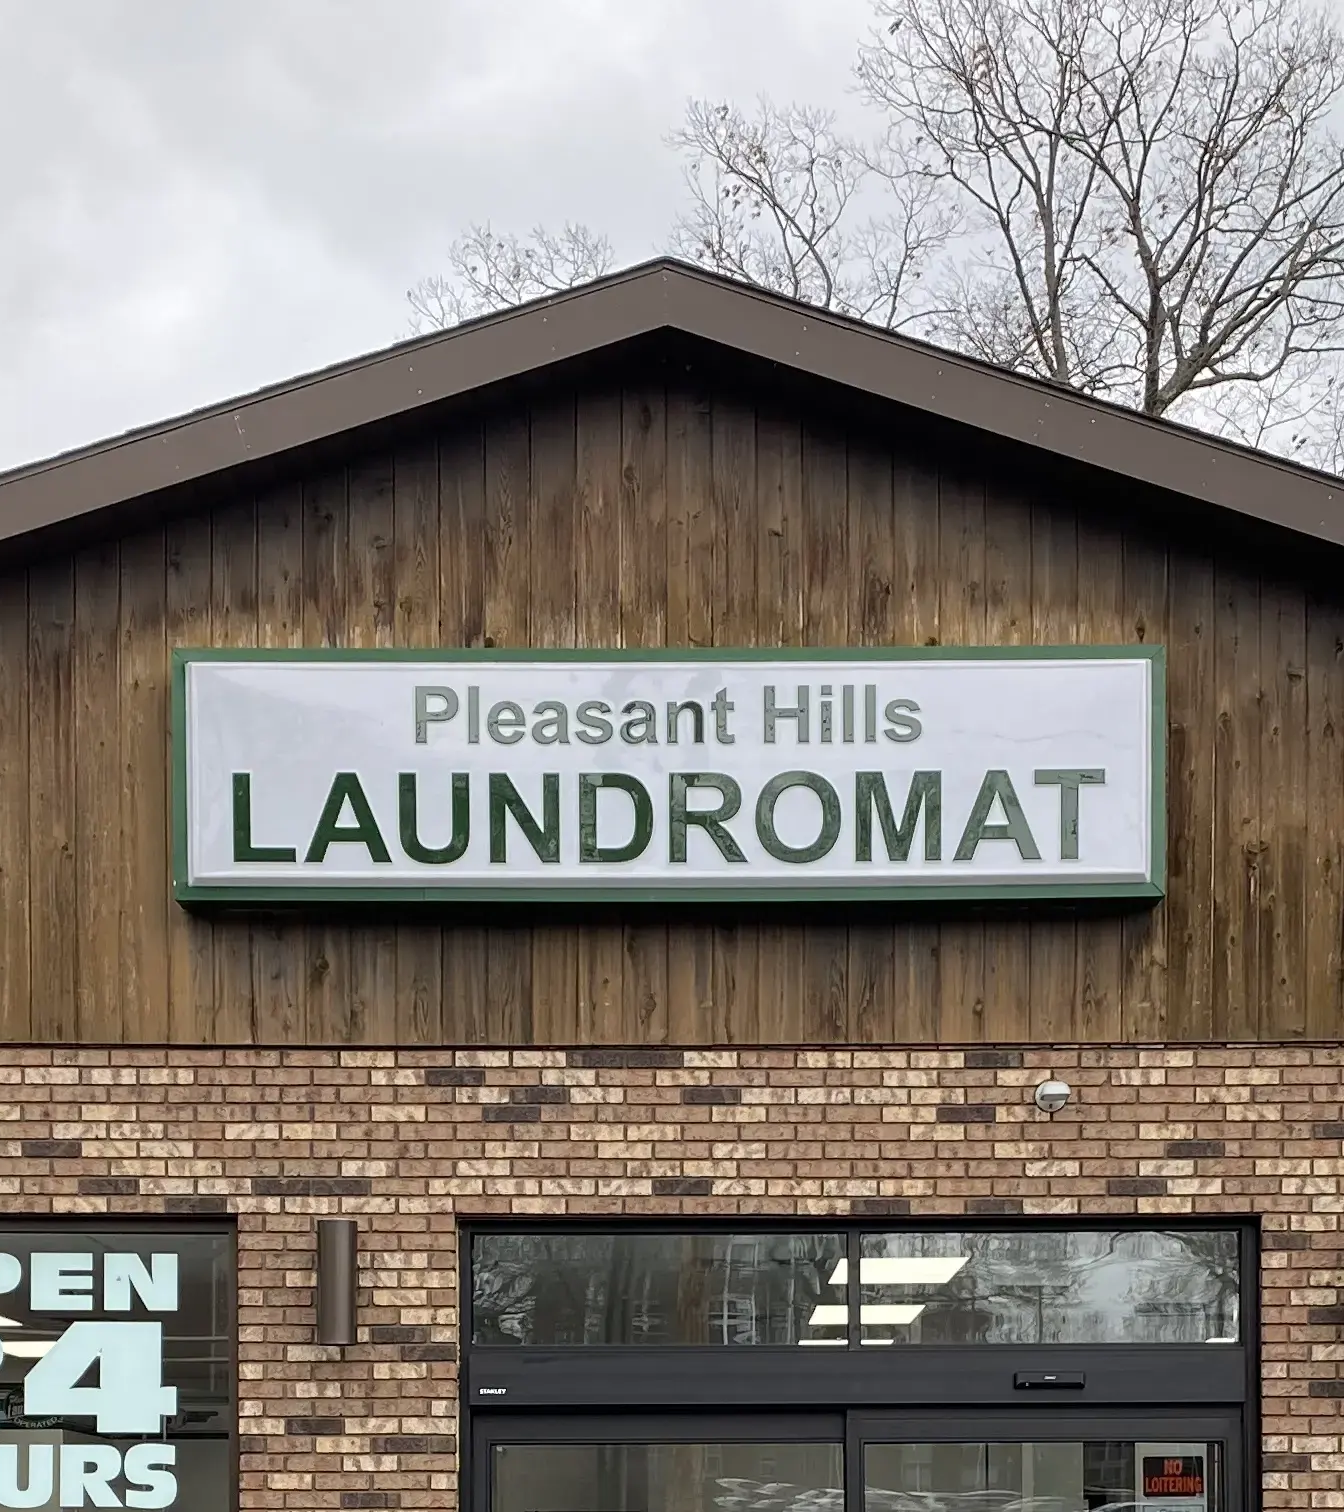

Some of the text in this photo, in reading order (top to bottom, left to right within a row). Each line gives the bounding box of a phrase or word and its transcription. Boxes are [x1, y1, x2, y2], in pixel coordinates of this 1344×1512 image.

[413, 683, 922, 744] Pleasant Hills
[232, 768, 1106, 864] LAUNDROMAT
[1145, 1477, 1203, 1493] LOITERING
[1164, 1459, 1183, 1475] NO
